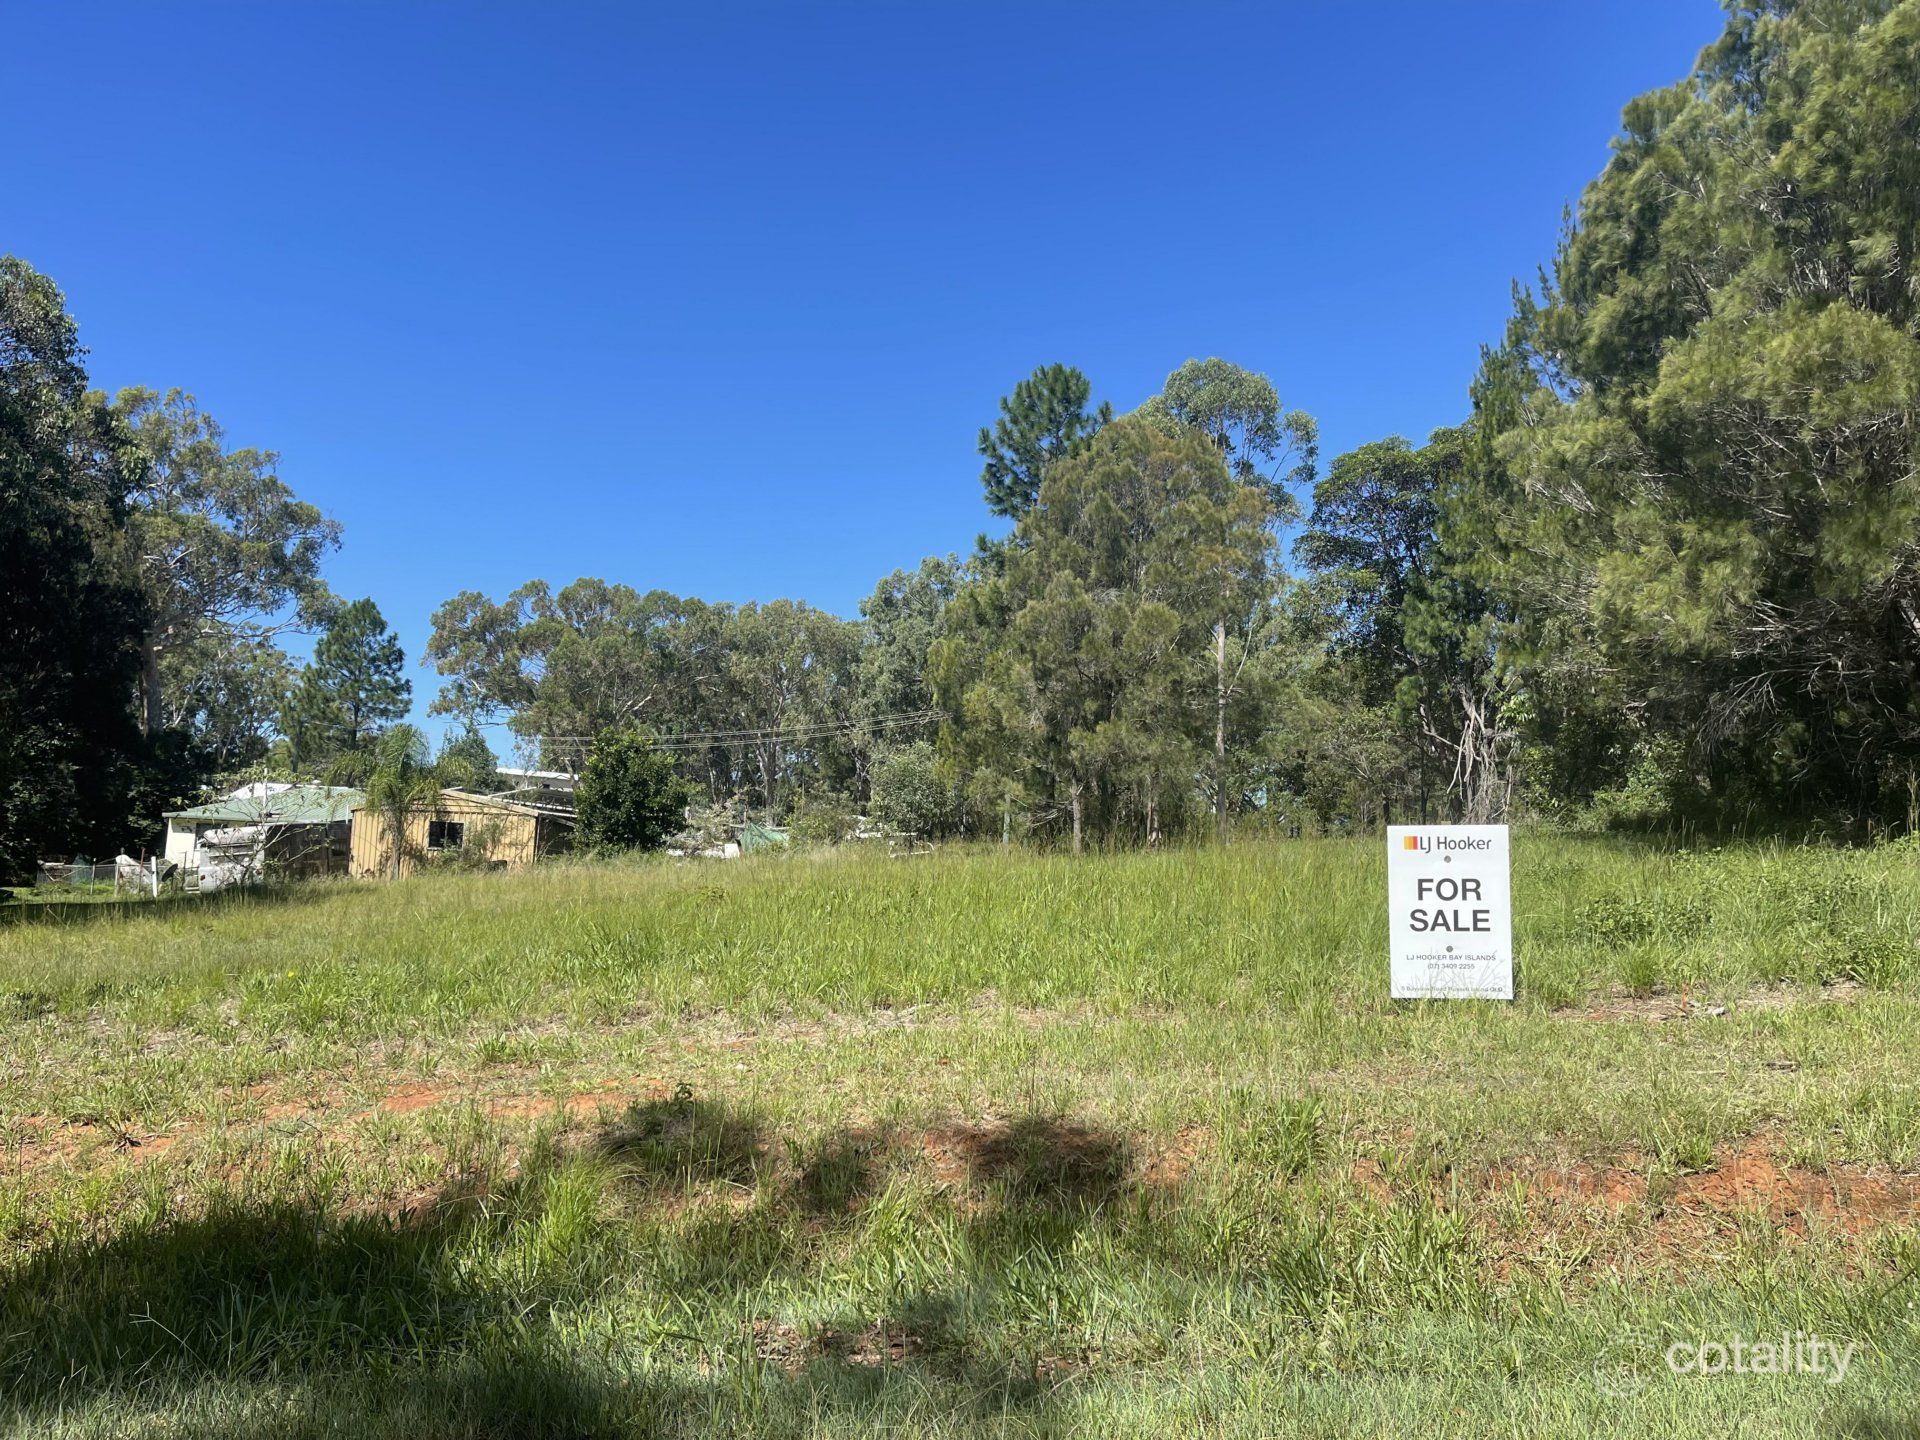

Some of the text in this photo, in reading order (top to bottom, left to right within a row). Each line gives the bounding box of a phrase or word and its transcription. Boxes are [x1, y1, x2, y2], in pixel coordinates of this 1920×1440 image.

[1420, 836, 1492, 853] LJ Hooker
[1417, 878, 1482, 901] FOR
[1409, 909, 1491, 932] SALE
